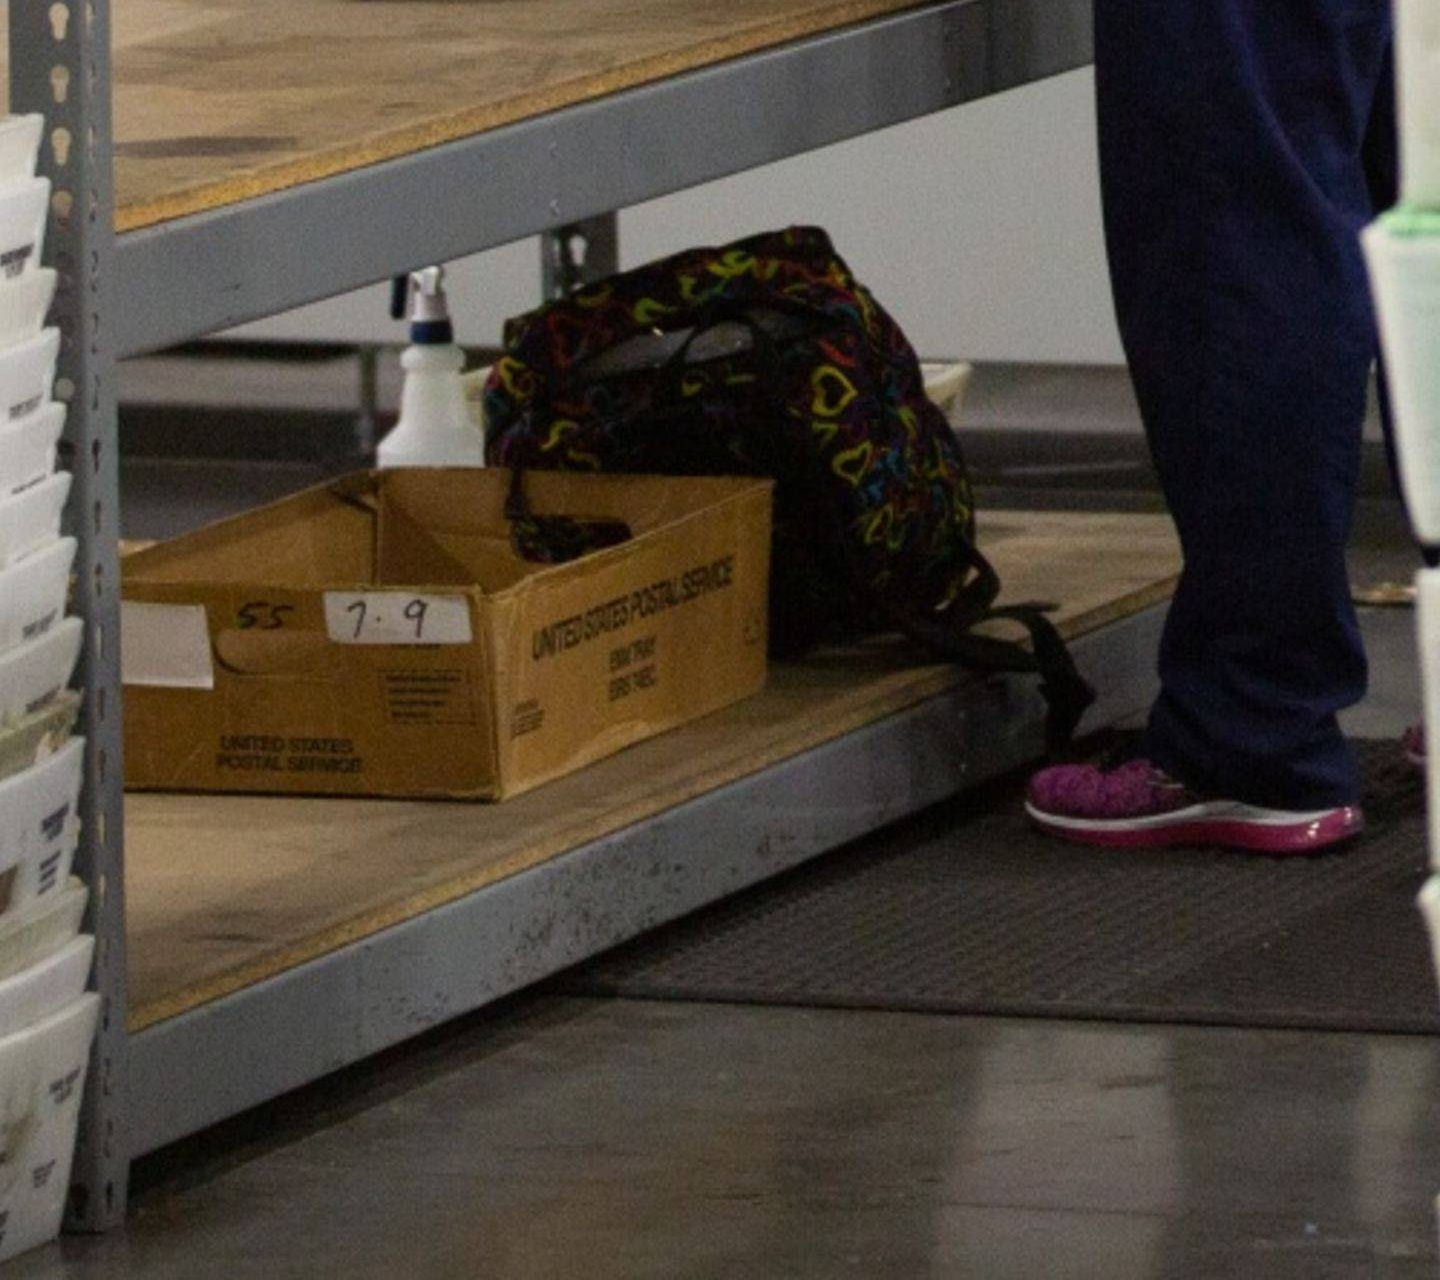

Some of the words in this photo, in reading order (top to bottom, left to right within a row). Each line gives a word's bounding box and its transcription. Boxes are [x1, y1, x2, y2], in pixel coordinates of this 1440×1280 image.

[219, 734, 288, 753] UNITED
[289, 736, 354, 754] STATES
[217, 754, 282, 772] POSTAL
[288, 756, 363, 773] SERVICE
